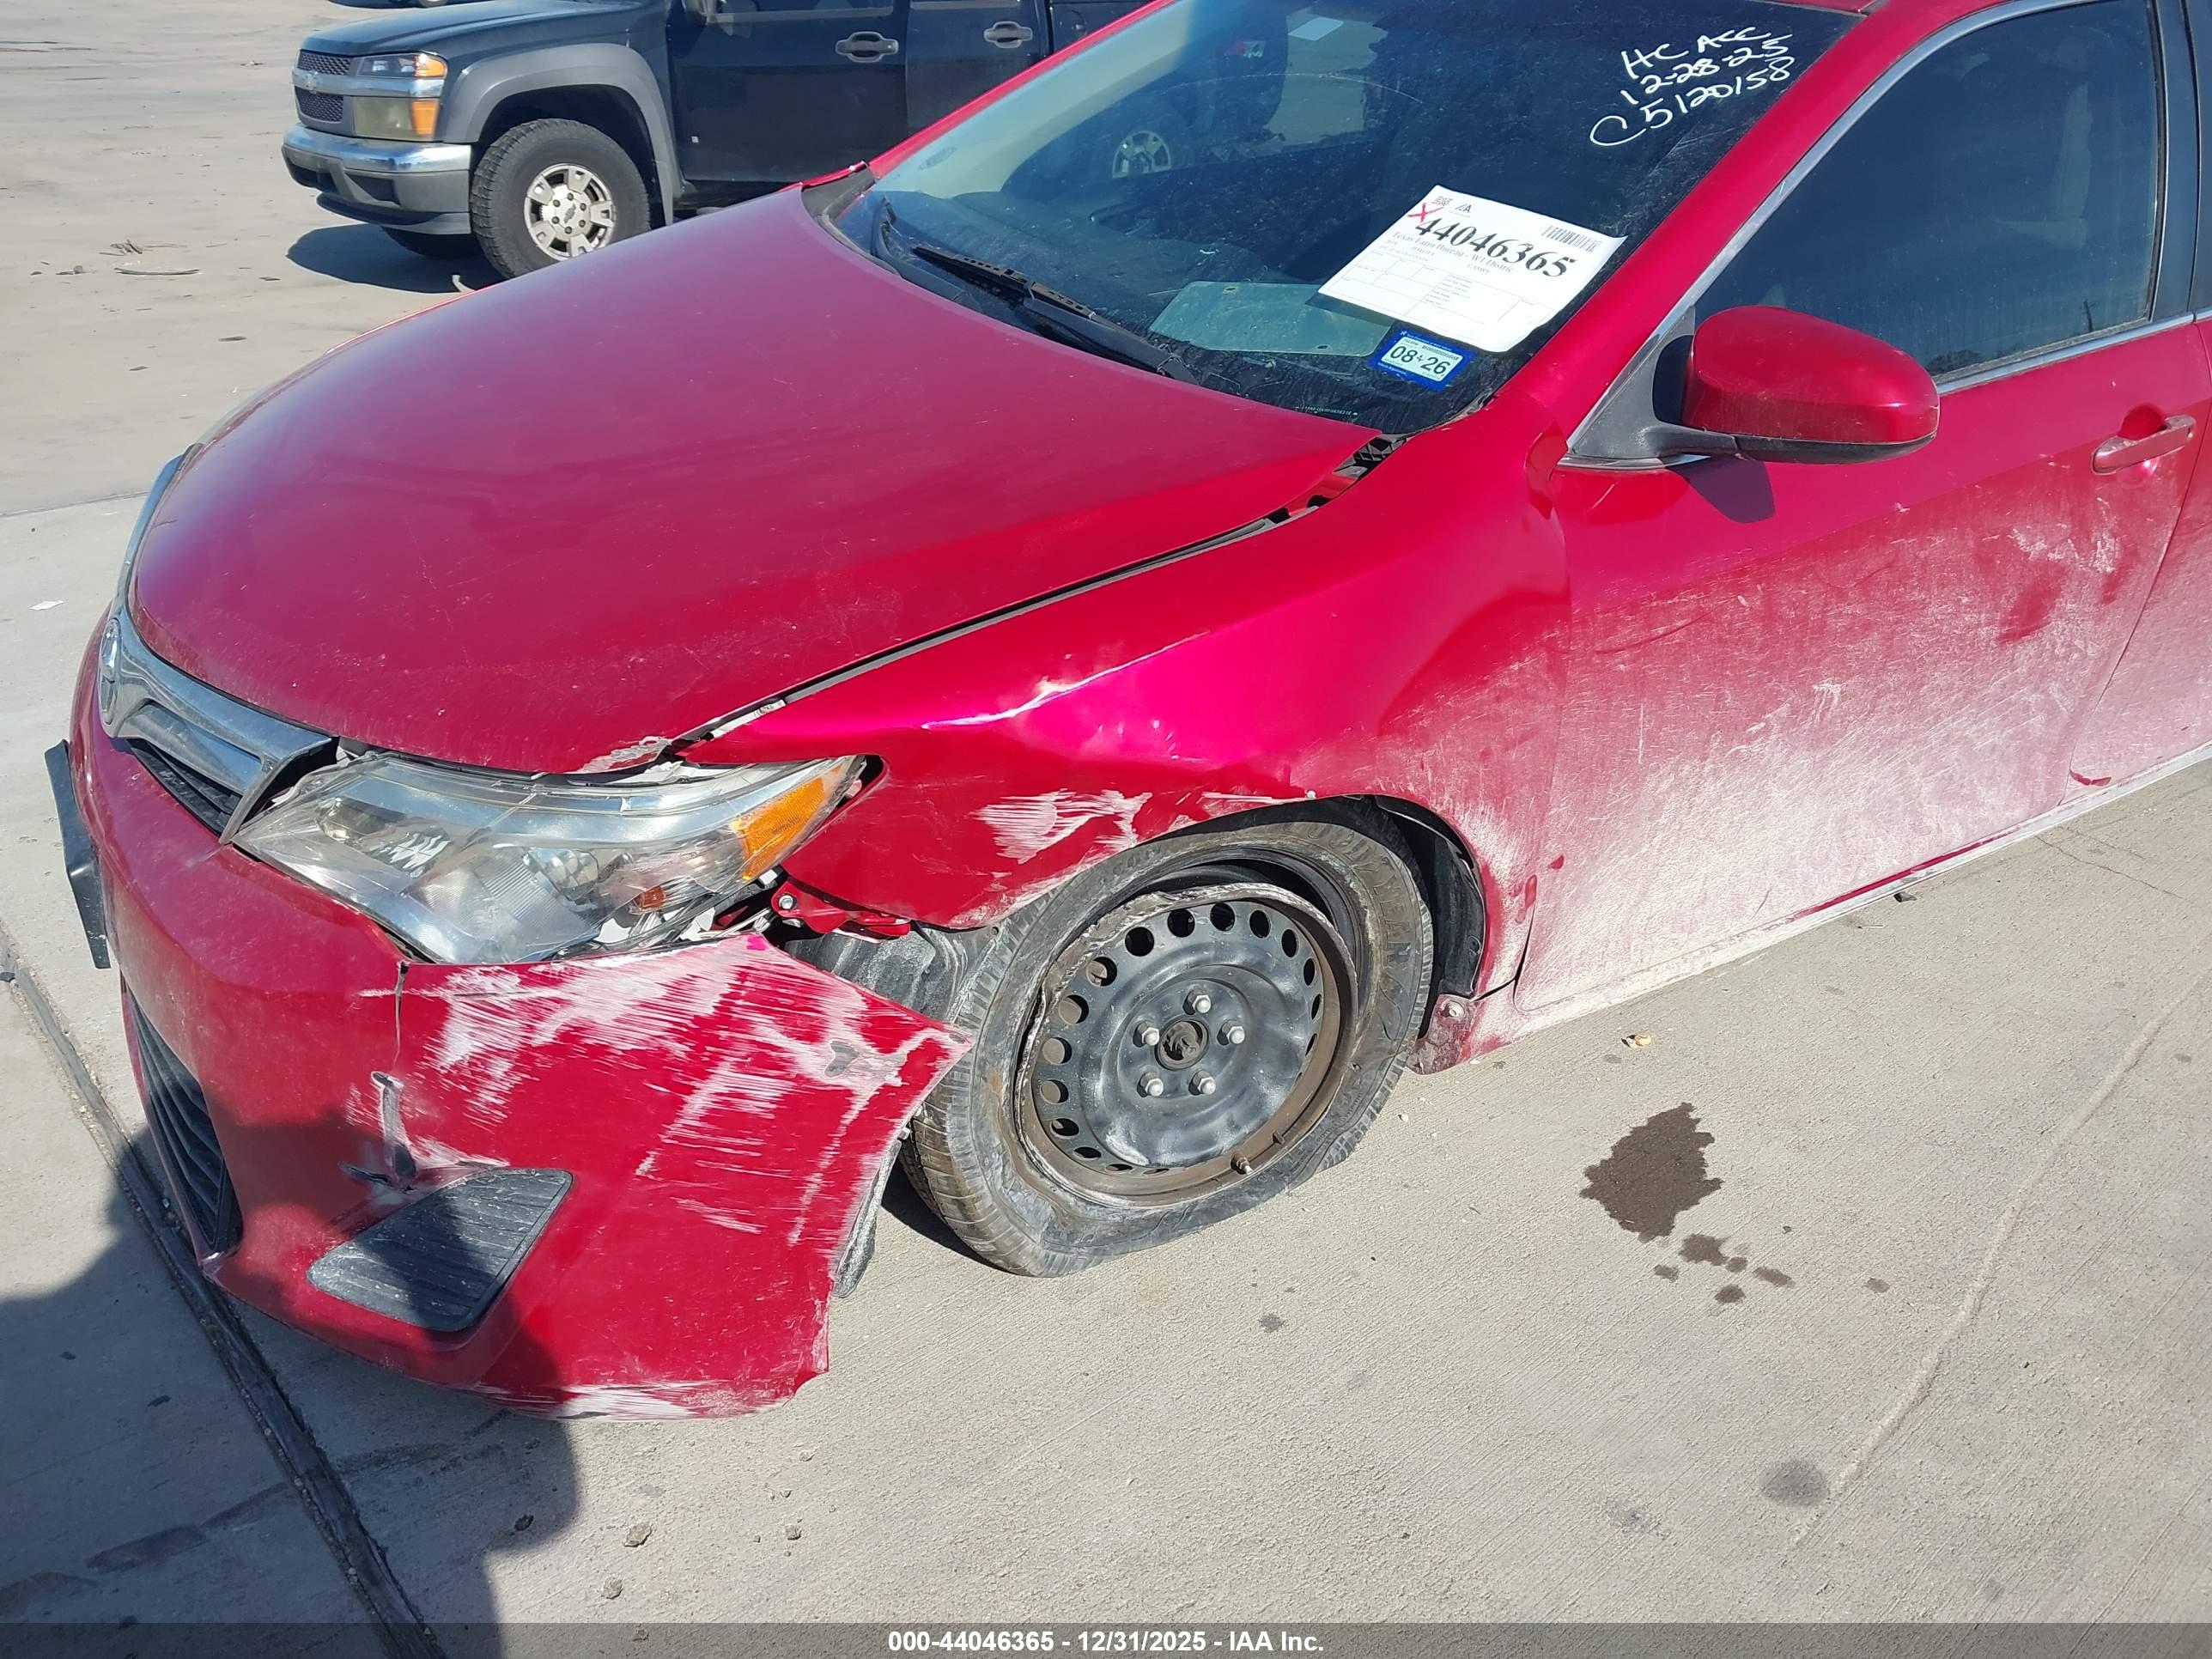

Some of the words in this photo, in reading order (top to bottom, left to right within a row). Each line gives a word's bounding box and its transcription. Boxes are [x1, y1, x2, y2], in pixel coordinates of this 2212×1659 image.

[1415, 218, 1577, 277] 44046365
[1390, 345, 1418, 363] 08
[1419, 356, 1451, 374] 26
